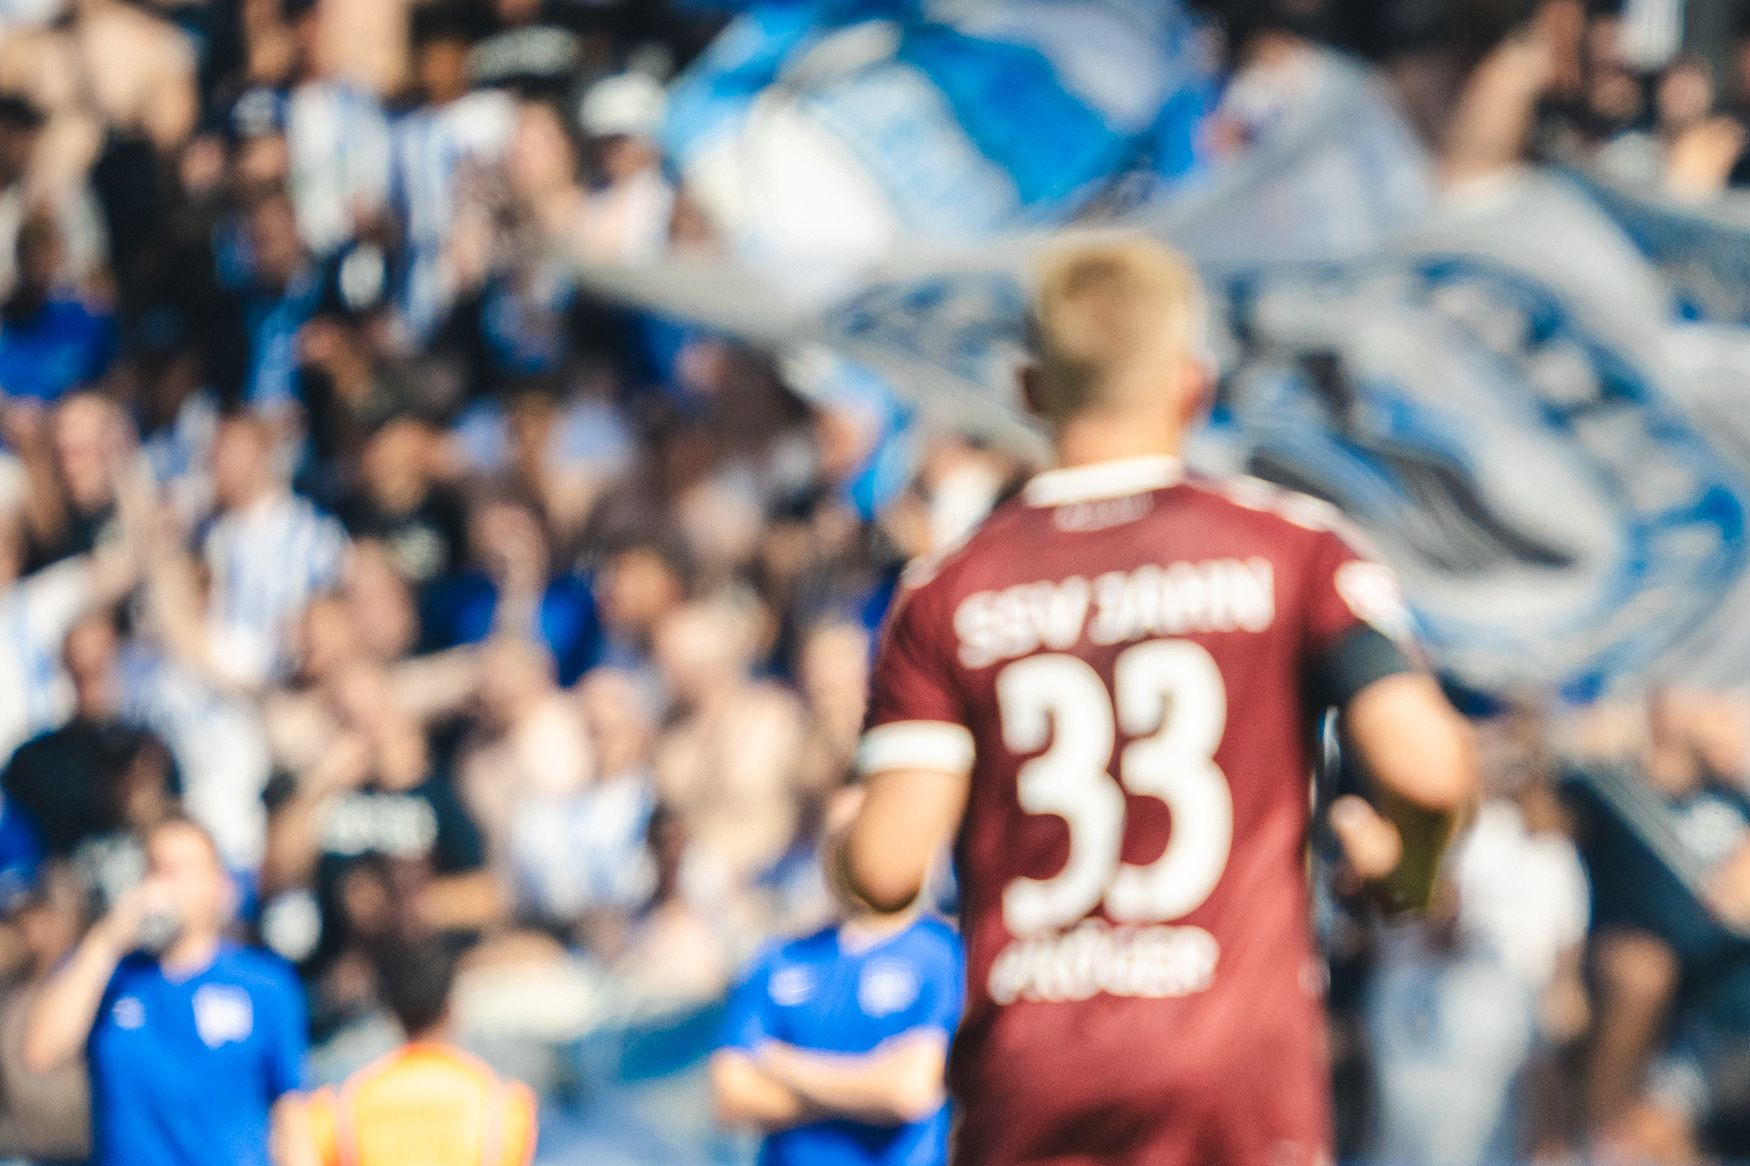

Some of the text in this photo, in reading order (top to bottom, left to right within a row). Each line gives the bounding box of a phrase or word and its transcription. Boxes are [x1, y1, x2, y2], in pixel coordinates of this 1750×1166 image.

[954, 555, 1276, 669] SSV JAHN
[996, 637, 1234, 940] 33
